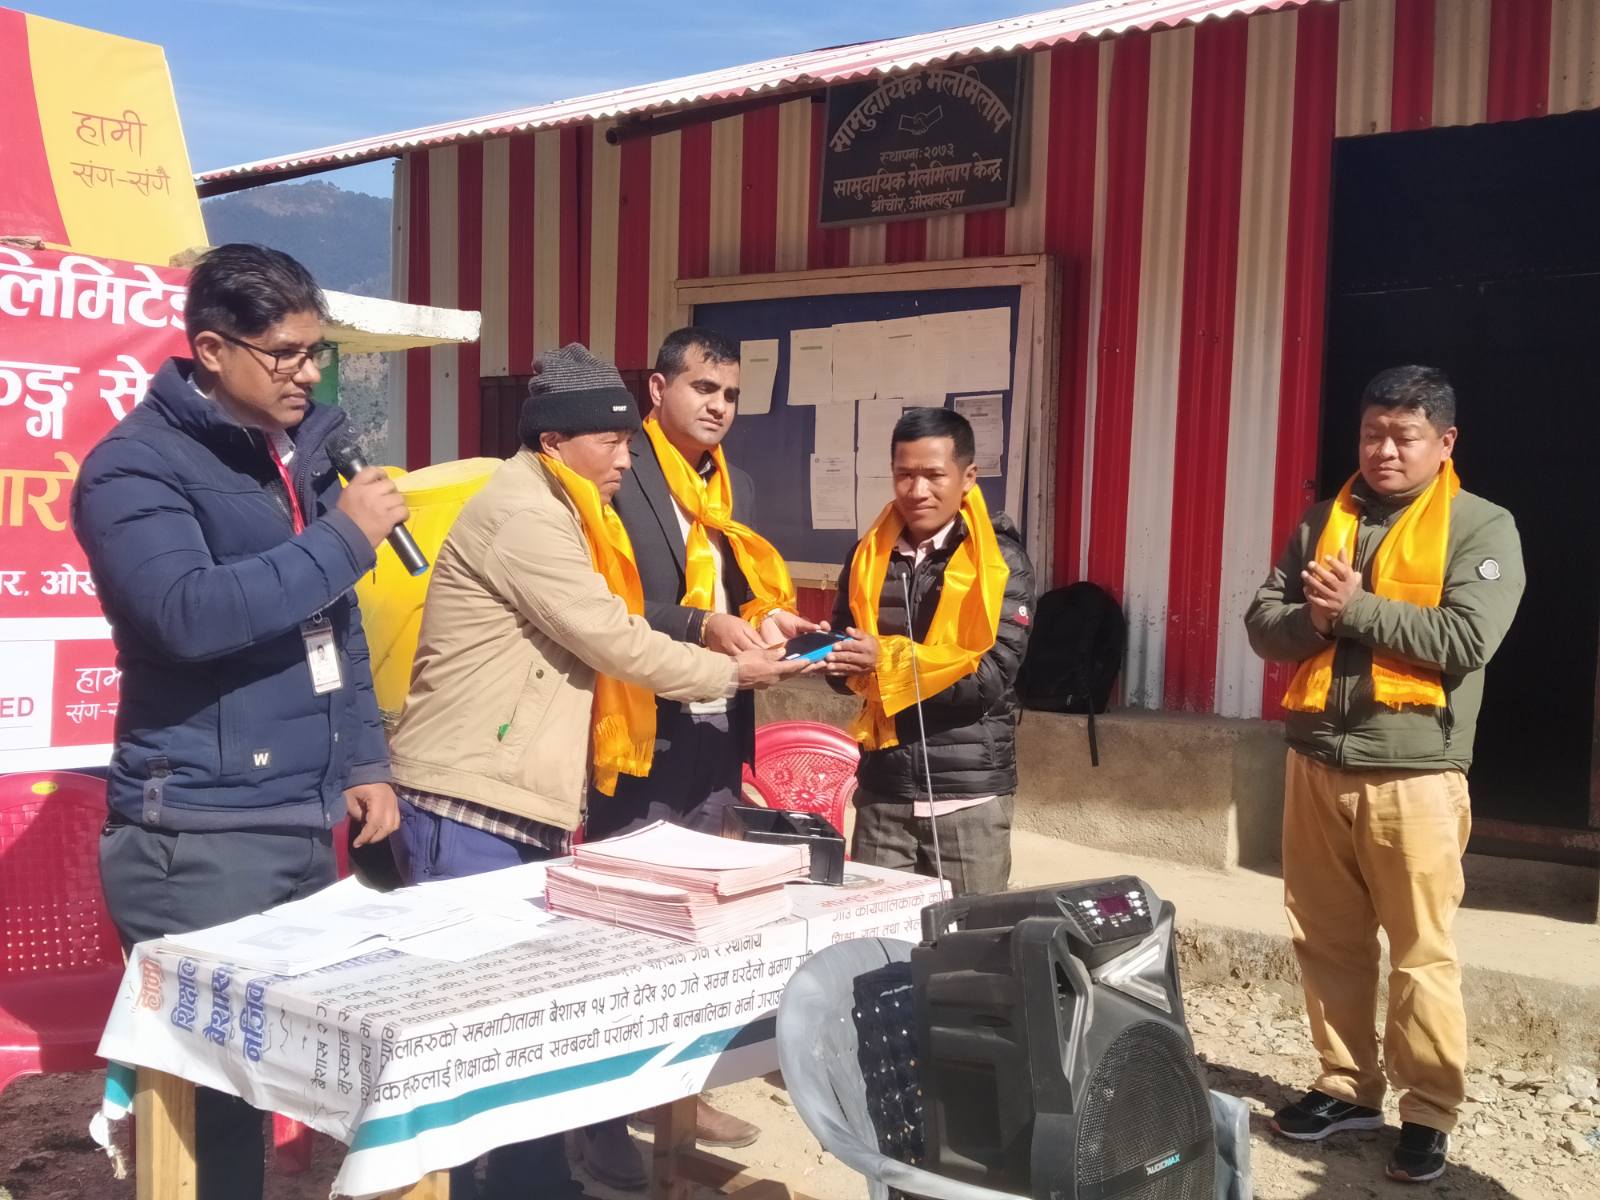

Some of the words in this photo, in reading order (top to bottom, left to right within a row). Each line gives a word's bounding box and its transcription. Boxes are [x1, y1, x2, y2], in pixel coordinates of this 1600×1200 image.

[927, 65, 1011, 134] मलमिलाप
[72, 109, 148, 158] हामी
[833, 167, 906, 200] सामुदायिक
[907, 160, 973, 189] मेलमिलाप
[972, 152, 1003, 182] केन्द्र
[99, 355, 155, 422] से
[75, 667, 122, 694] हाम
[253, 752, 269, 766] W
[390, 1022, 458, 1061] लाहरुको
[549, 999, 588, 1024] बैशाख
[609, 986, 630, 1011] गते
[633, 984, 658, 1007] देखि
[660, 983, 677, 1001] ३०
[680, 972, 700, 996] गते
[703, 970, 730, 992] सम्म
[454, 1048, 501, 1082] शिक्षाको
[647, 1012, 671, 1036] गरी
[673, 1001, 733, 1029] बालबालिका
[735, 990, 756, 1015] भर्ना
